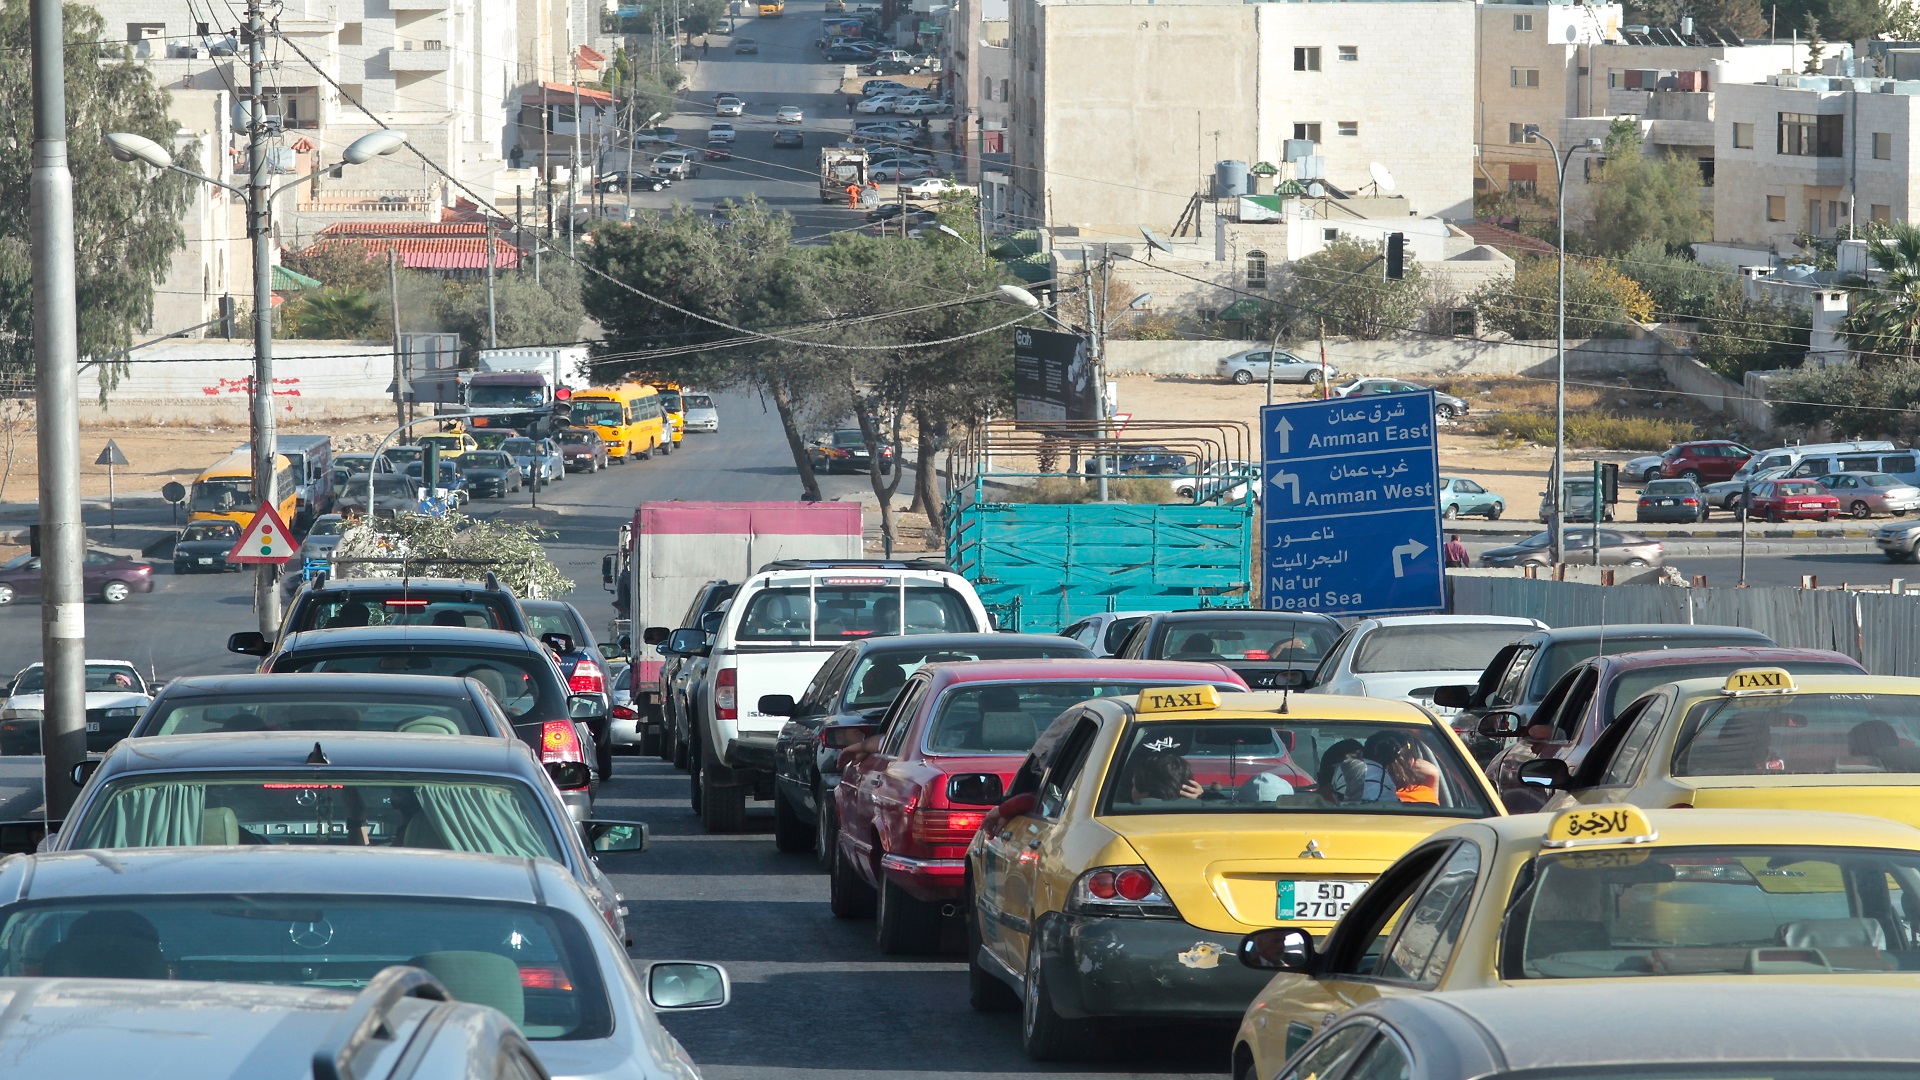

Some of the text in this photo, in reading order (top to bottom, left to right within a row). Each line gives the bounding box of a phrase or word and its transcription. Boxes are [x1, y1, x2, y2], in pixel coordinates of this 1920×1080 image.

[1328, 402, 1405, 425] شرق عمان
[1308, 423, 1428, 449] Amman East
[1329, 458, 1409, 481] غرب عمان
[1305, 482, 1432, 506] Amman West
[1272, 549, 1348, 571] البحر الميت
[1271, 575, 1322, 591] Na'ur
[1271, 591, 1362, 610] Dead Sea
[1735, 673, 1782, 688] TAXI
[1150, 693, 1202, 709] TAXI
[1567, 810, 1629, 836] للأجرة
